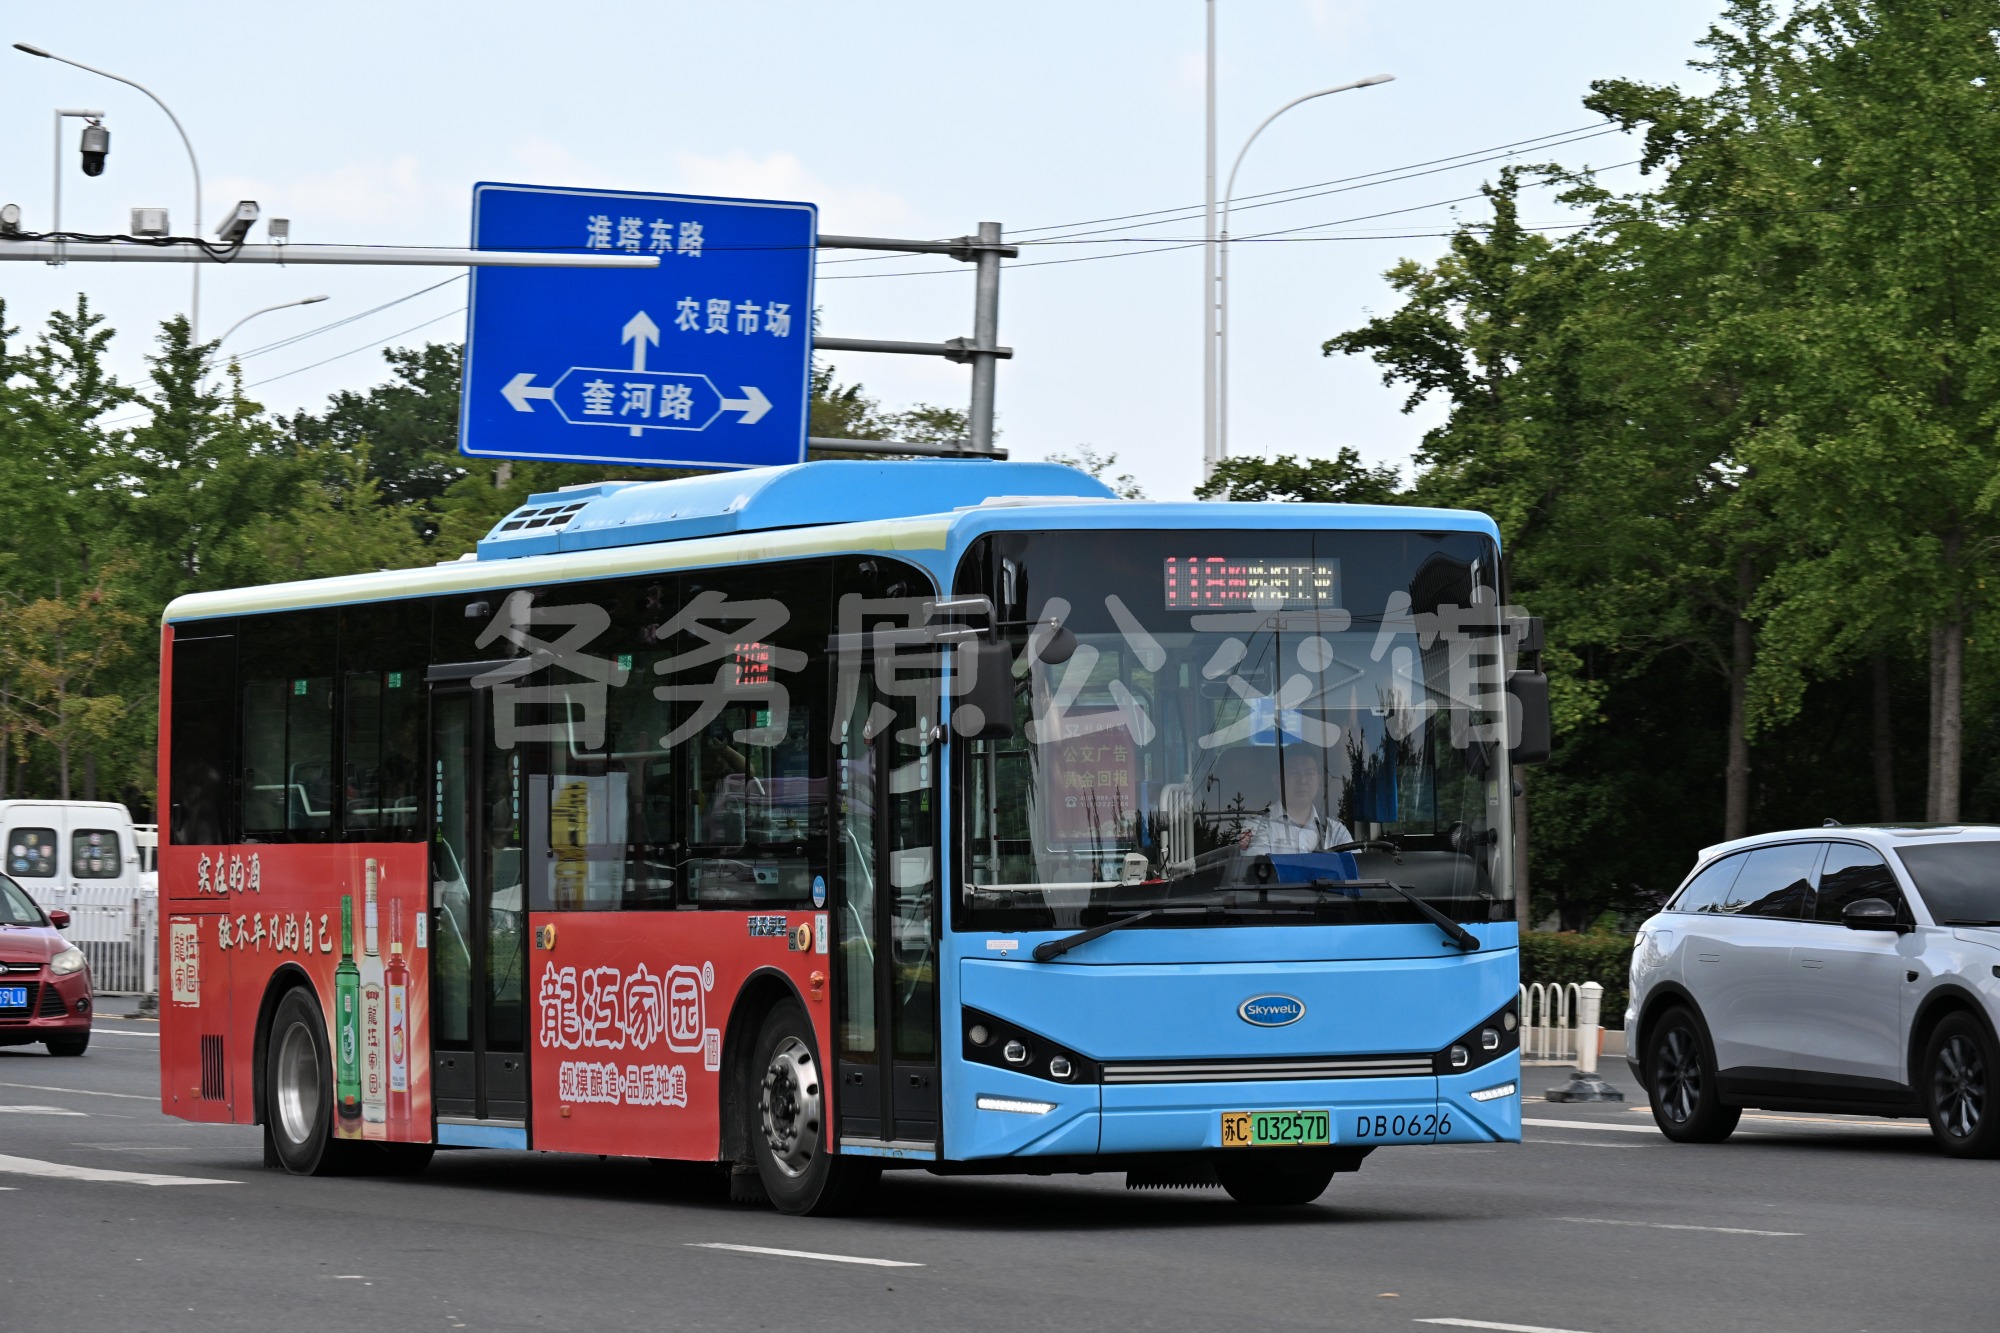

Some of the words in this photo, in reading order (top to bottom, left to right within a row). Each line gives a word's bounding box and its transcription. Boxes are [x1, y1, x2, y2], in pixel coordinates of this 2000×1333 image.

[586, 215, 705, 257] 淮塔东路
[674, 296, 791, 338] 农贸市场
[582, 379, 694, 421] 奎河路
[1063, 745, 1128, 763] 公交广告
[1063, 769, 1129, 789] 黄金回报
[198, 851, 260, 893] 实在的酒
[0, 990, 26, 1005] 9LU
[1247, 1004, 1299, 1016] Skywell
[1356, 1113, 1453, 1138] DB0626
